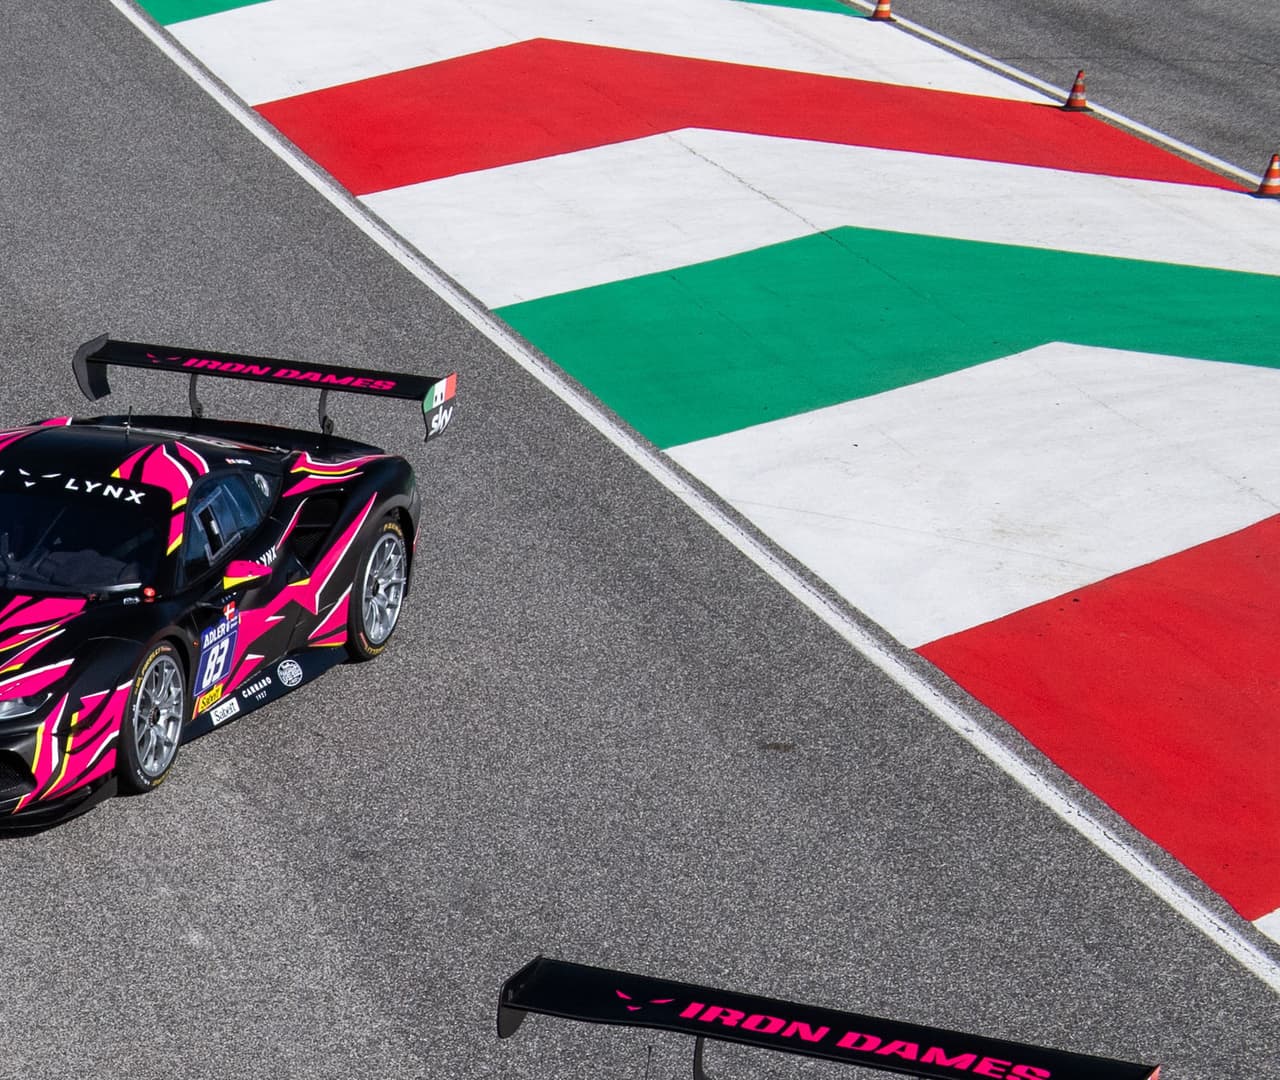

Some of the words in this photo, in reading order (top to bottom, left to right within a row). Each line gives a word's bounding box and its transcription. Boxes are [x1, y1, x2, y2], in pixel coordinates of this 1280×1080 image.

[183, 357, 271, 376] IRON
[273, 368, 397, 391] DAMES
[64, 477, 146, 507] LYNX
[203, 622, 225, 649] ADLER
[202, 637, 230, 689] 83
[241, 676, 272, 699] CARRARO
[215, 702, 238, 723] Sabelt
[679, 1001, 828, 1043] IRON
